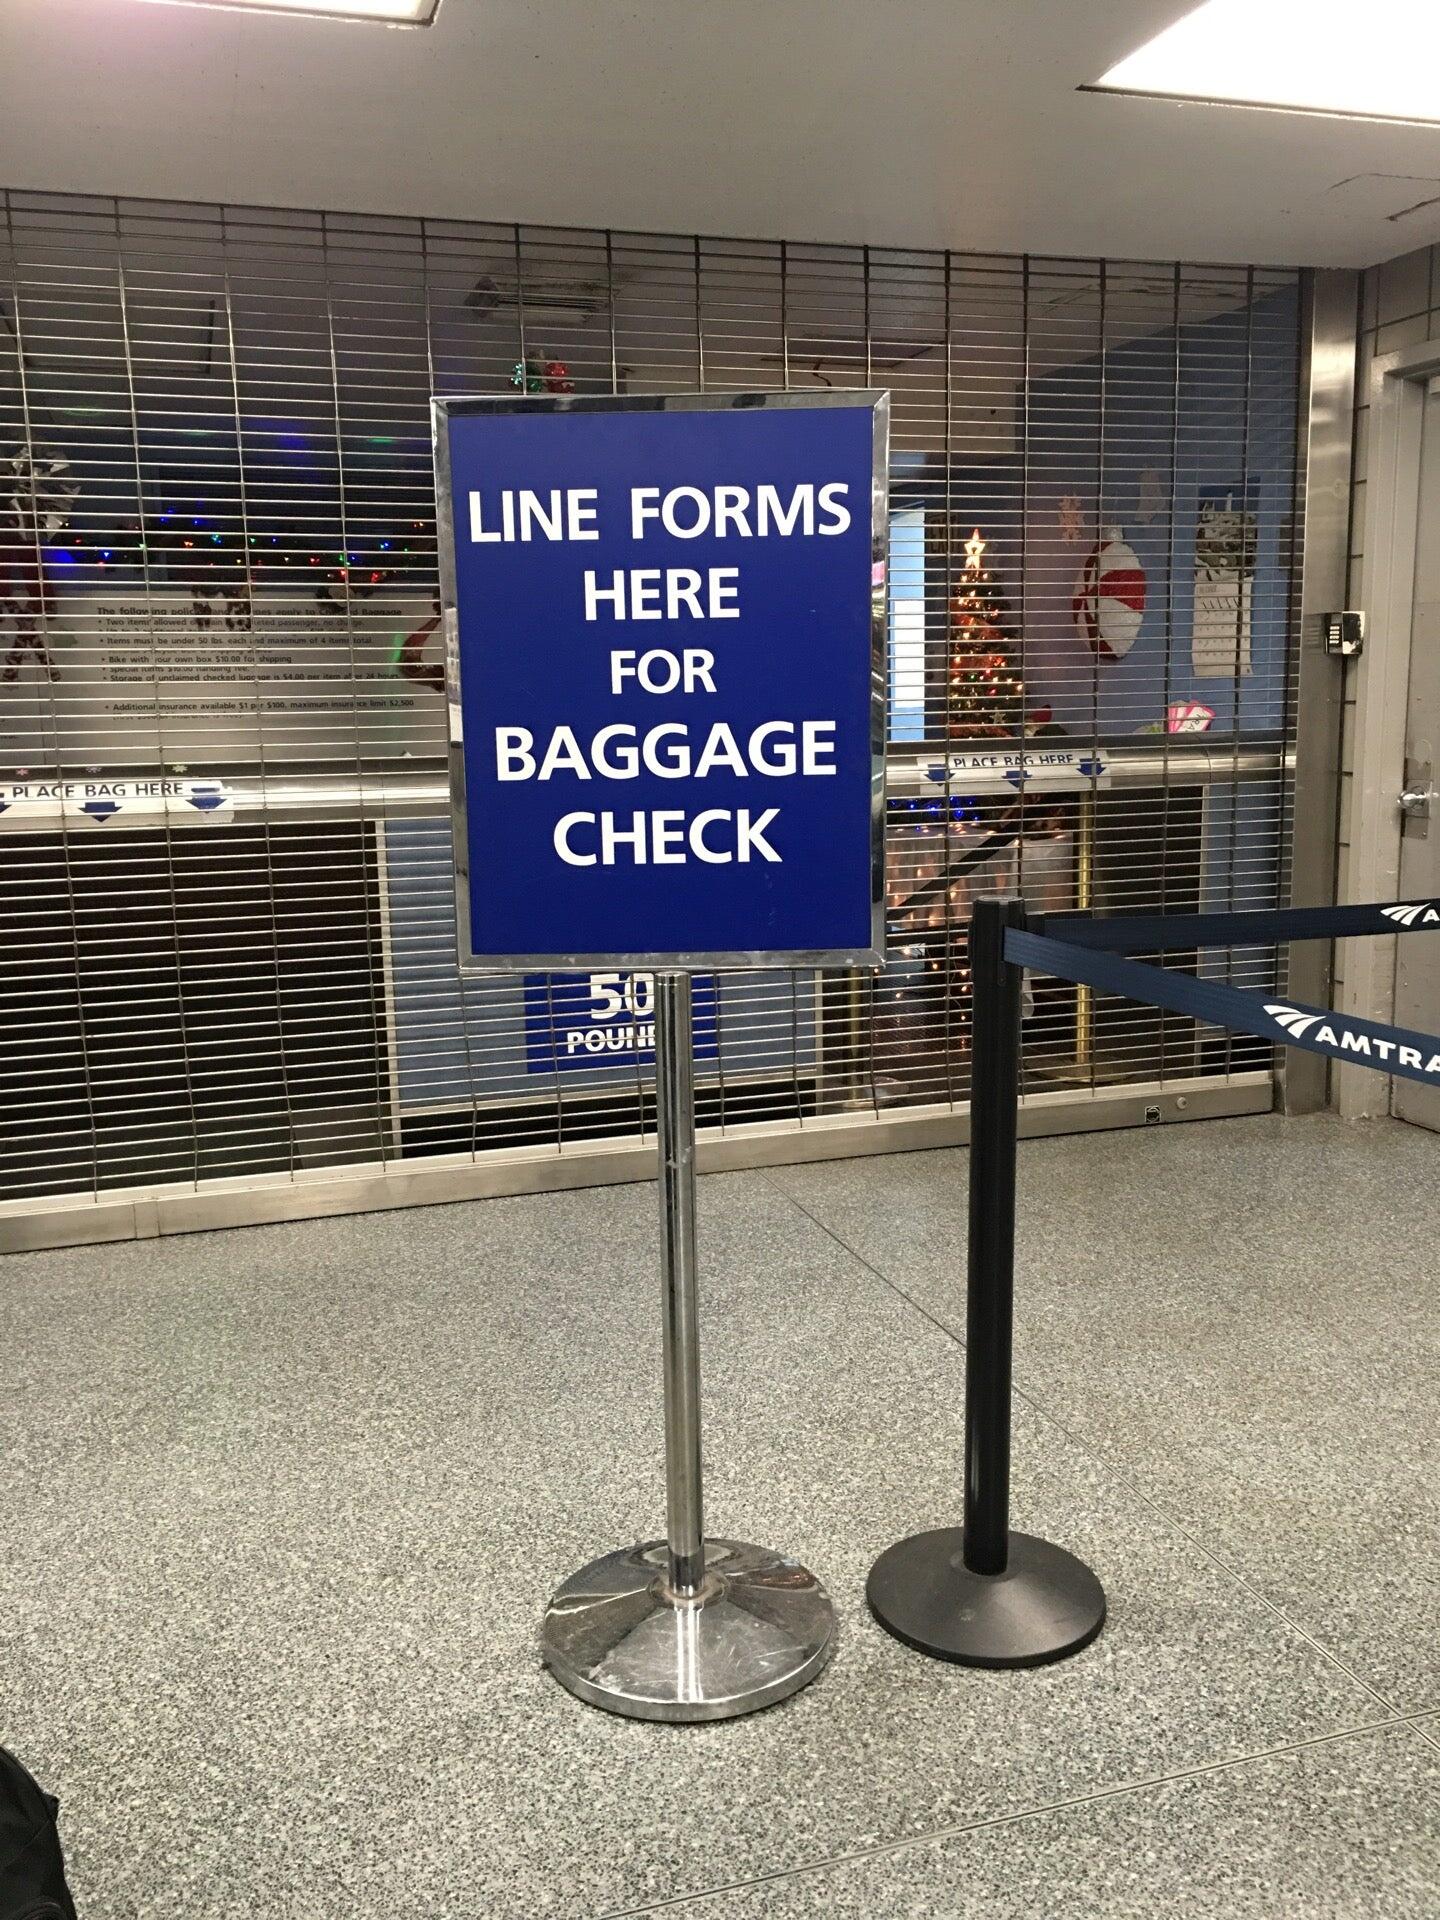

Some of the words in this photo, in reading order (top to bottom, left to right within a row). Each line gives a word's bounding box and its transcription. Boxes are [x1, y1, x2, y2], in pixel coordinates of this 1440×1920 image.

[469, 489, 599, 543] LINE
[631, 483, 851, 539] FORMS
[584, 567, 740, 621] HERE
[97, 607, 115, 616] The
[106, 618, 124, 626] Two
[128, 618, 150, 626] items
[153, 618, 186, 626] allowed
[106, 637, 130, 645] Items
[157, 637, 169, 645] be
[171, 637, 194, 645] under
[198, 637, 208, 645] 50
[227, 637, 246, 645] each
[108, 656, 127, 664] Bike
[258, 656, 292, 665] shipping
[610, 648, 717, 695] FOR
[110, 674, 143, 682] Storage
[146, 674, 155, 682] of
[273, 673, 280, 681] is
[283, 673, 304, 681] $4.00
[113, 703, 155, 711] Additional
[158, 703, 197, 711] insurance
[200, 702, 236, 710] available
[239, 702, 247, 710] $1
[250, 703, 262, 711] pr
[369, 700, 386, 708] limit
[495, 720, 837, 782] BAGGAGE
[12, 783, 75, 798] PLACE
[85, 783, 126, 797] BAG
[135, 781, 183, 797] HERE
[553, 808, 783, 867] CHECK
[589, 972, 656, 1020] 50
[1314, 1025, 1440, 1073] AMTRA
